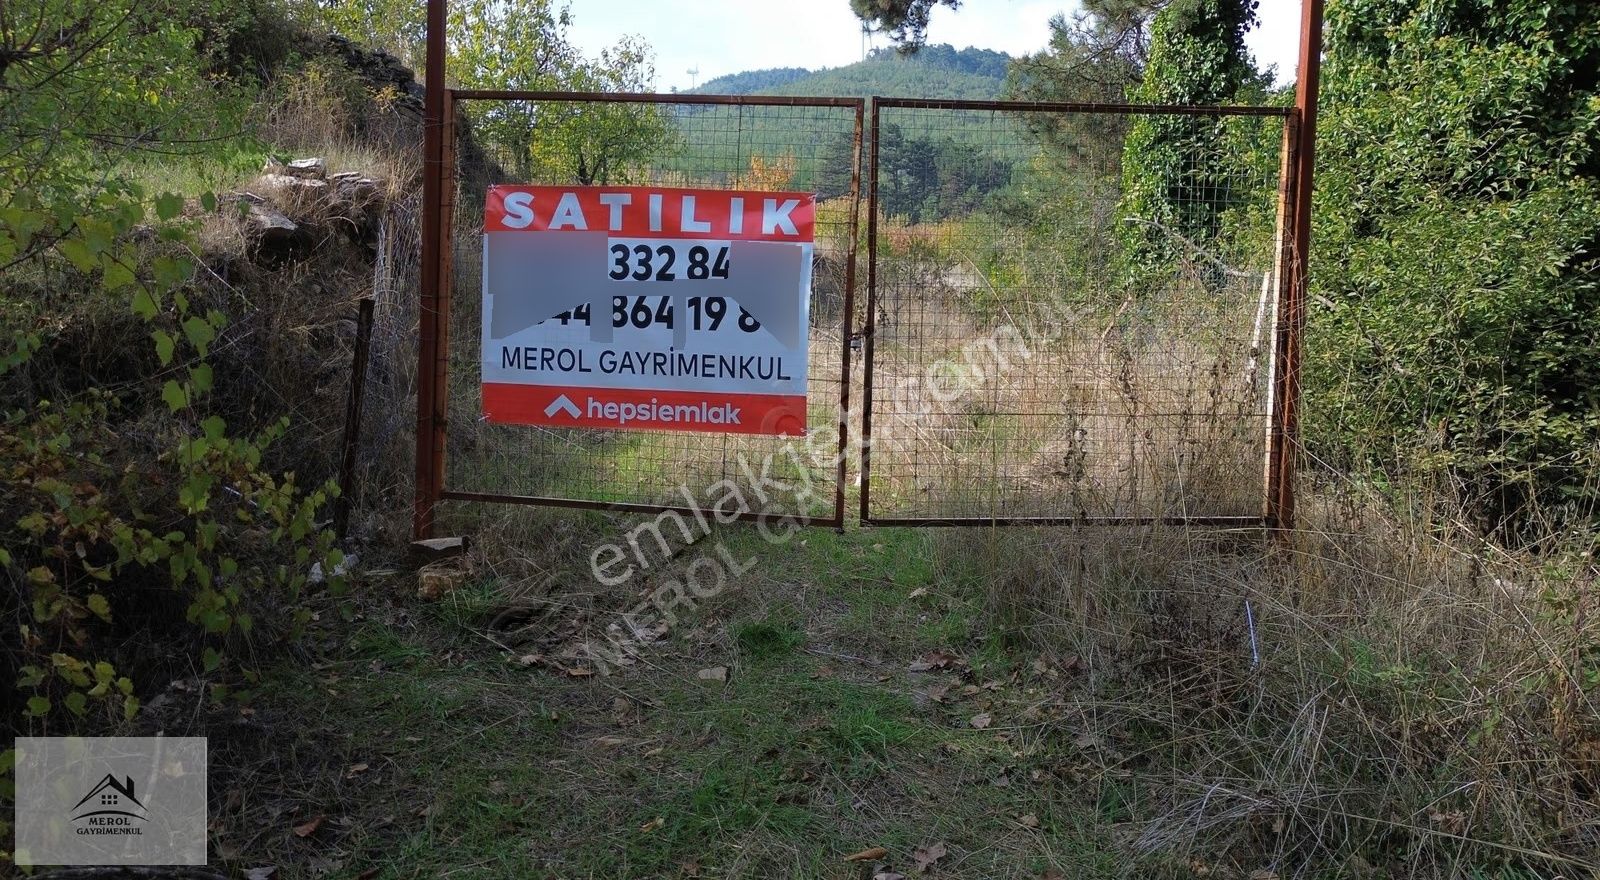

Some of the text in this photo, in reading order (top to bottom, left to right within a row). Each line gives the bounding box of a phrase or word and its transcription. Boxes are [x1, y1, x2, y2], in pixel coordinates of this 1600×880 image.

[501, 191, 801, 236] SATILIK
[608, 243, 676, 282] 332
[687, 296, 727, 331] 19
[501, 345, 791, 381] MEROL GAYRİMENKUL
[587, 397, 742, 425] hepsiemlak
